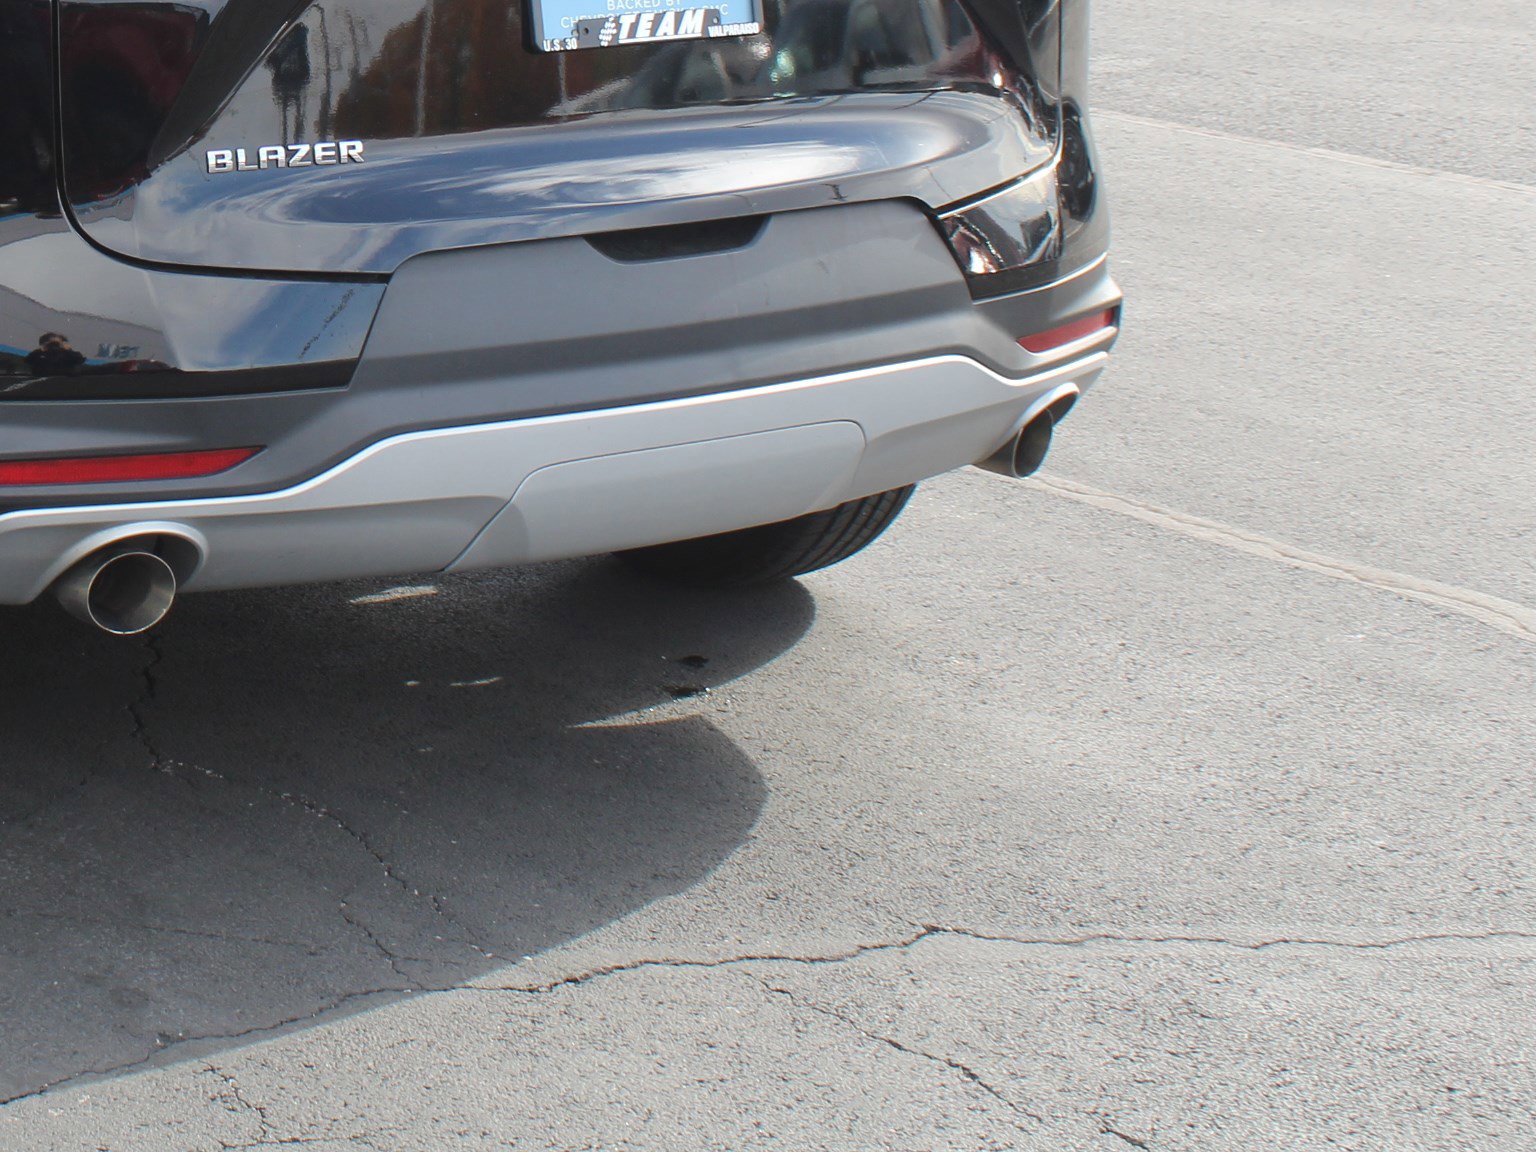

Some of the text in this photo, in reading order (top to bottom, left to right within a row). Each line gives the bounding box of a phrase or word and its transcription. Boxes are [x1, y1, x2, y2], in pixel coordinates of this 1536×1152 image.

[618, 9, 705, 40] TEAM
[543, 38, 578, 52] U.S. 30
[207, 140, 364, 174] BLAZER
